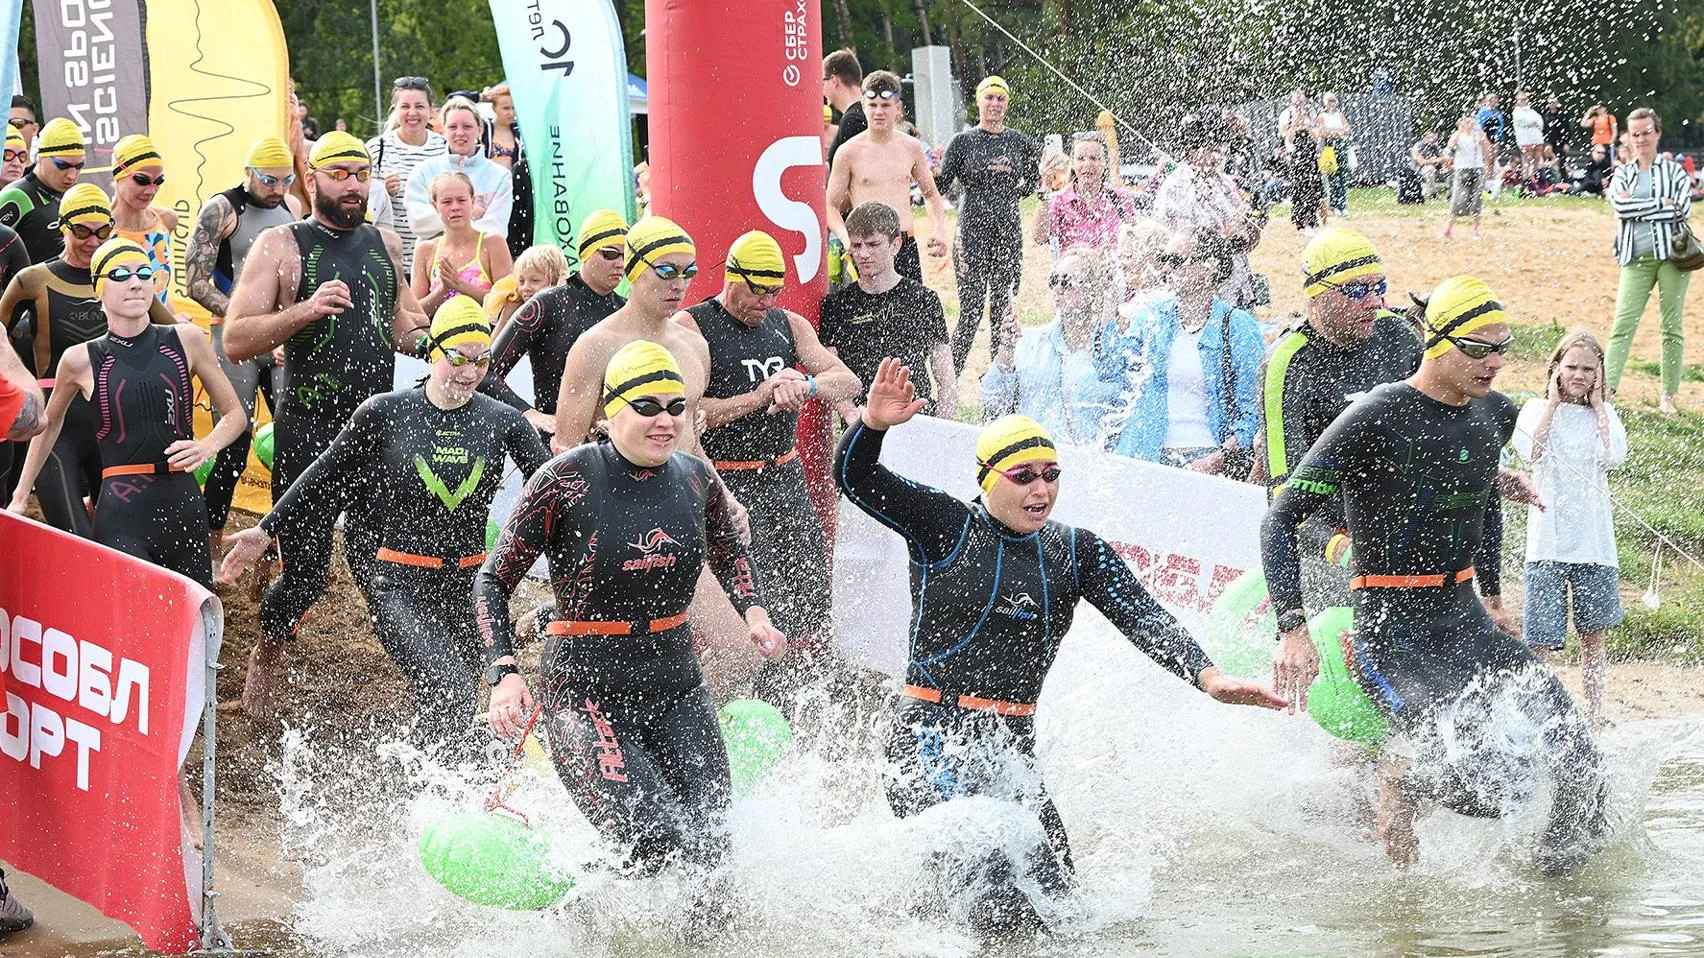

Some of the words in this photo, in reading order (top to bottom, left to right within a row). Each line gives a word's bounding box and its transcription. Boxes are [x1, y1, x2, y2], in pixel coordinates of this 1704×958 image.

[784, 10, 797, 61] СБЕР
[796, 0, 808, 61] СТРАХ
[109, 336, 134, 348] 2XU
[741, 356, 786, 383] TYR
[165, 388, 176, 425] 2XU
[433, 454, 468, 464] WAVE
[436, 446, 465, 455] MAD
[622, 554, 677, 572] sailfish
[995, 605, 1037, 621] sailfish
